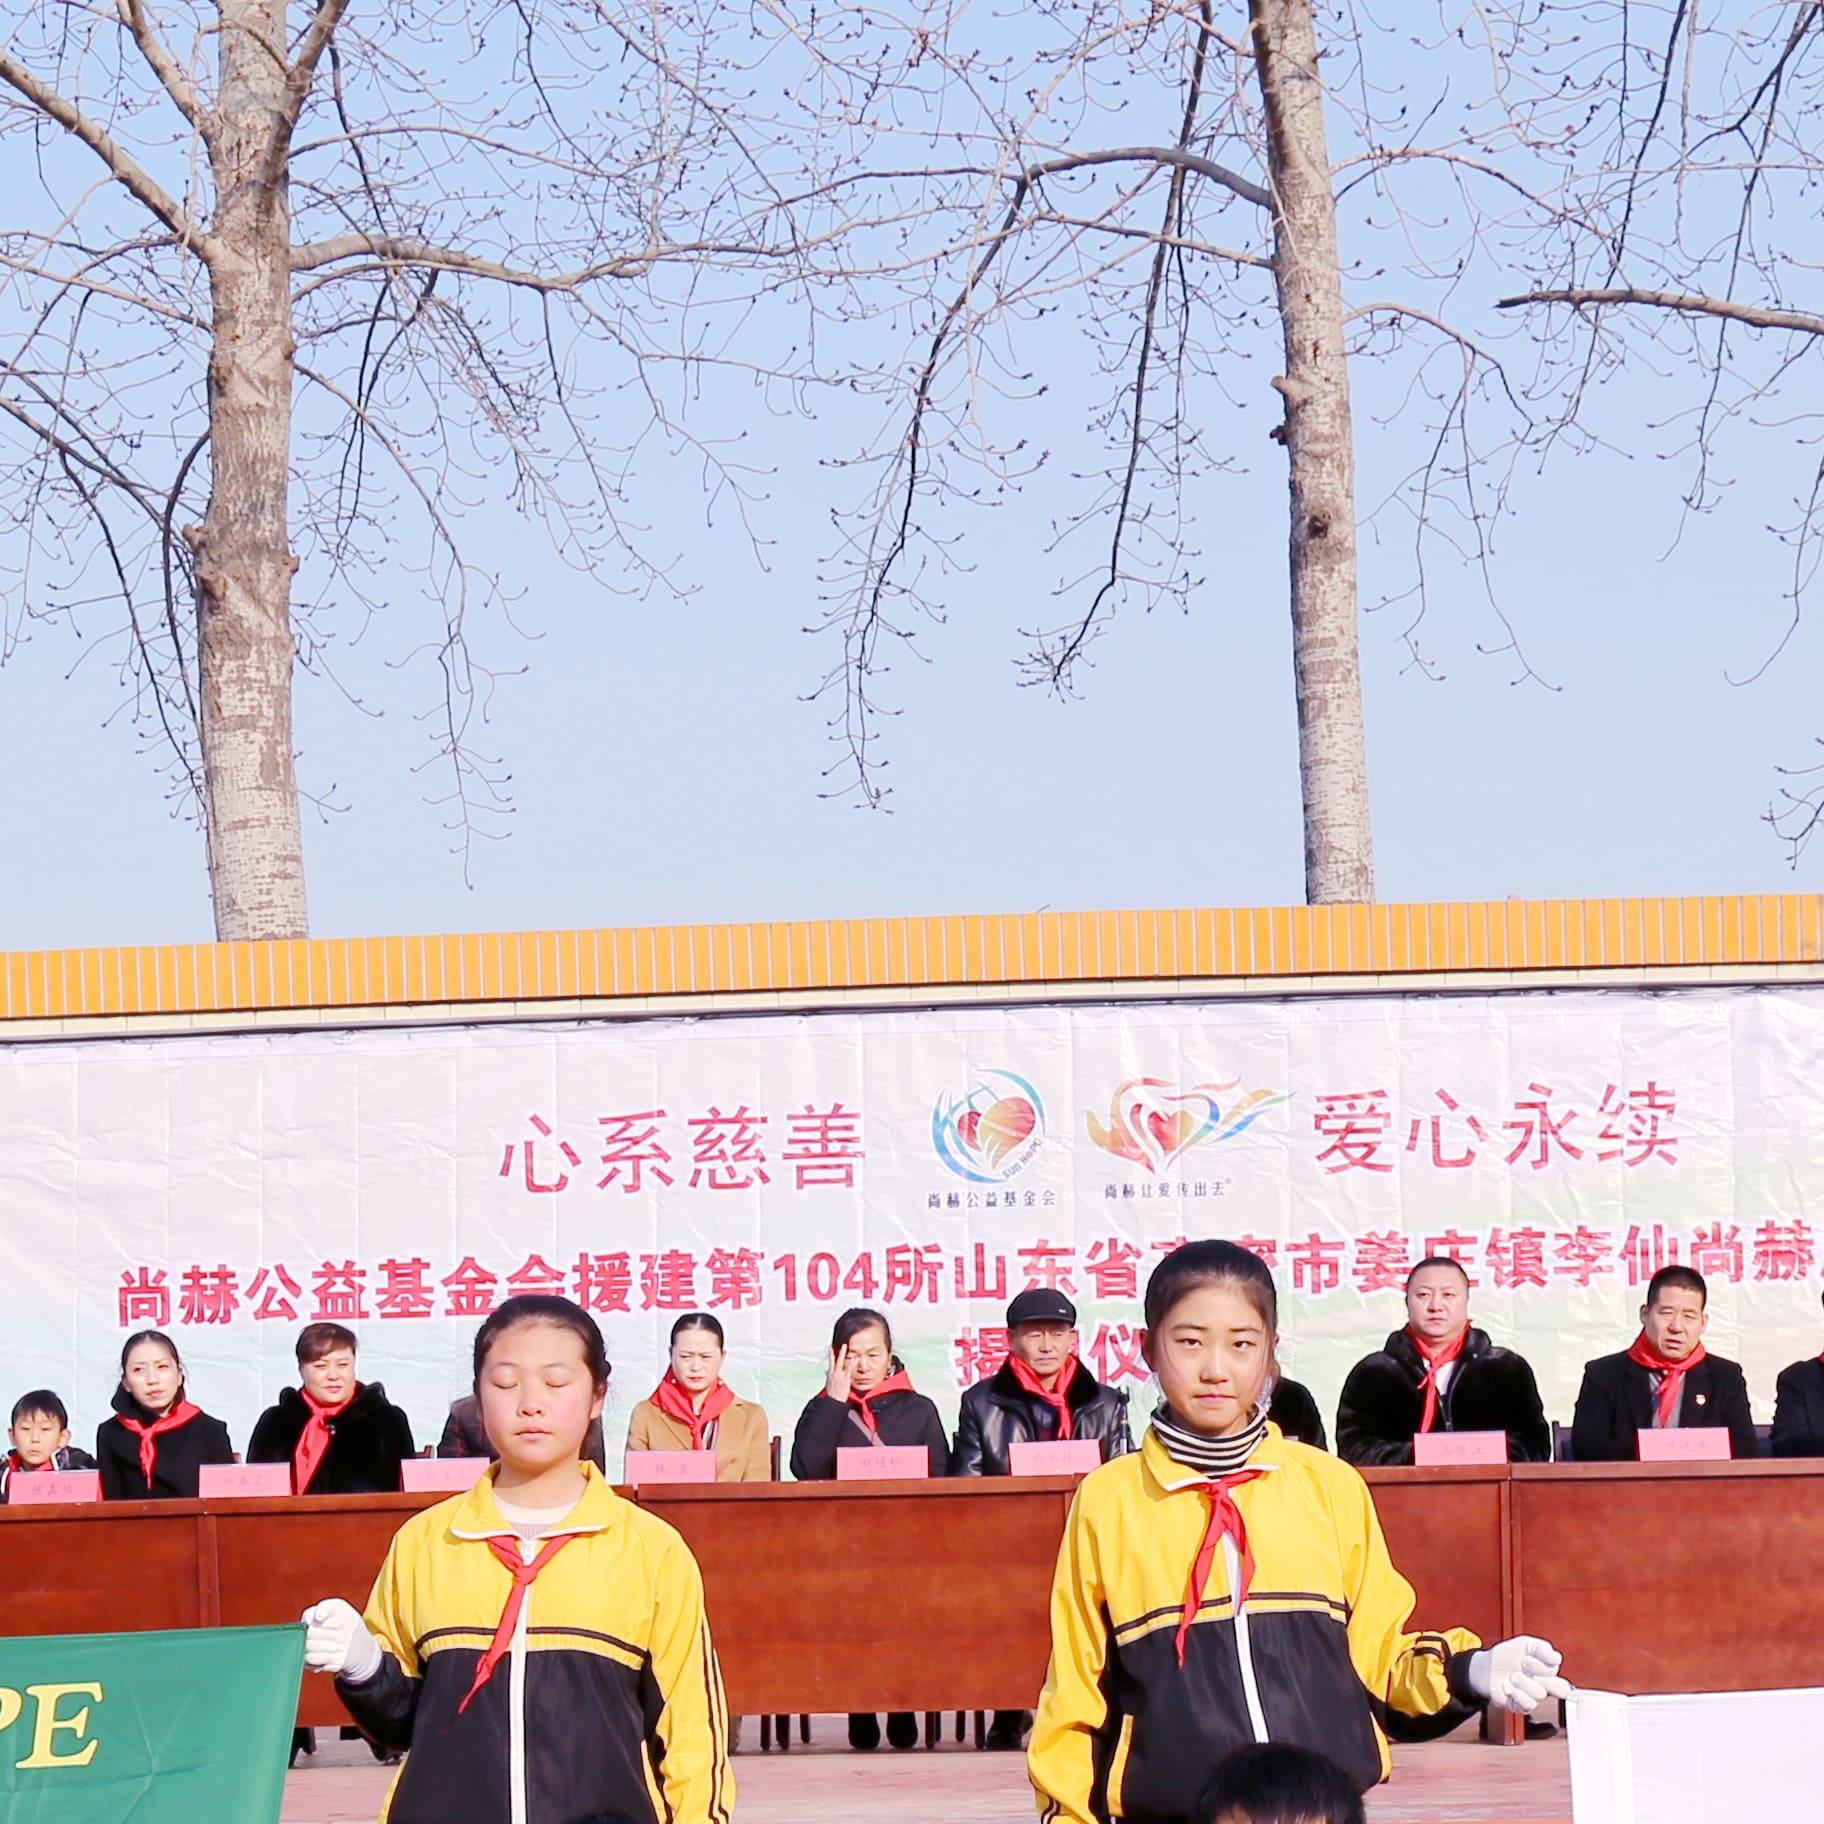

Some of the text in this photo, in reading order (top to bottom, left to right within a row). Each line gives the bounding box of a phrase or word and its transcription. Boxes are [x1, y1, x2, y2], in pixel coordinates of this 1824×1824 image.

[499, 1102, 864, 1195] 心系慈善
[1313, 1080, 1680, 1175] 爱心永续
[927, 1188, 1057, 1210] 尚赫公益基金会
